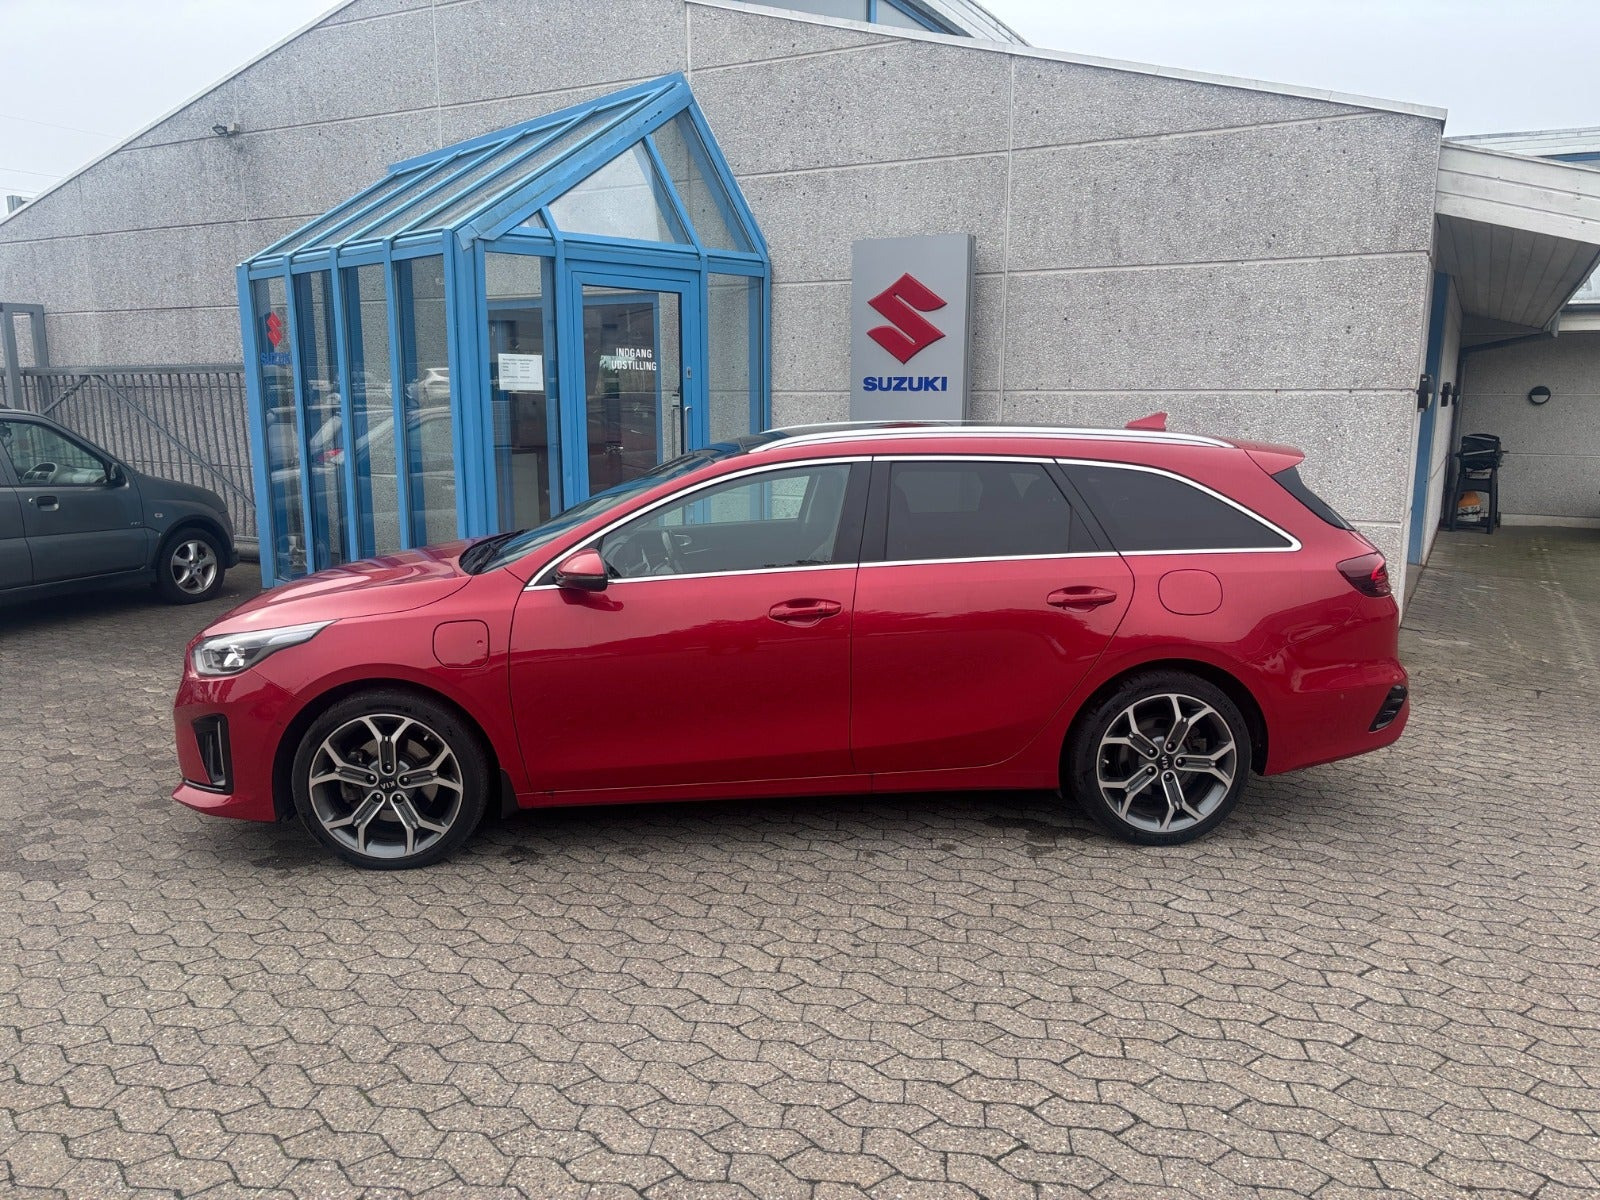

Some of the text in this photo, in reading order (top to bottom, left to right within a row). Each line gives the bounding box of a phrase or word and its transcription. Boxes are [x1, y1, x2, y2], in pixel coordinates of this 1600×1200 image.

[615, 347, 652, 359] INDGANG
[611, 360, 657, 371] UDSTILLING
[863, 376, 948, 392] SUZUKI
[380, 780, 396, 790] KIA
